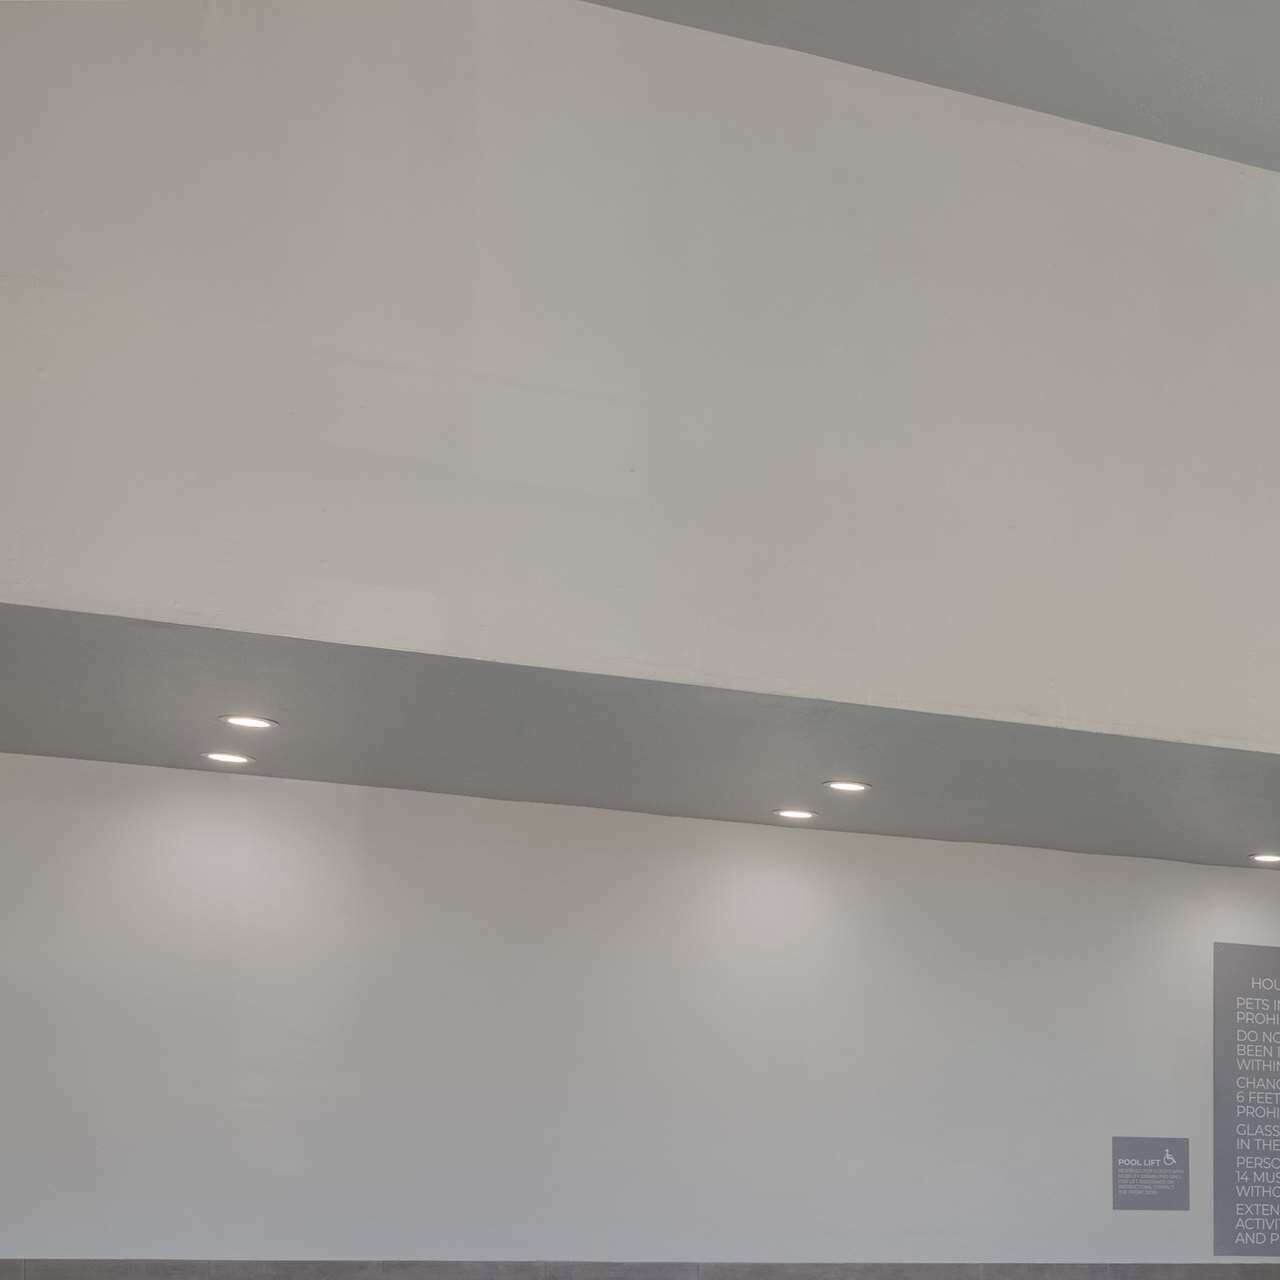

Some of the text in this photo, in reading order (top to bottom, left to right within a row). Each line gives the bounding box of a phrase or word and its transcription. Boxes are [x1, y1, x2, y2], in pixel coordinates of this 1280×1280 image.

[1235, 996, 1269, 1011] PETS
[1236, 1029, 1258, 1043] DO
[1236, 1044, 1273, 1058] BEEN
[1235, 1090, 1245, 1103] 6
[1248, 1091, 1280, 1105] FEET
[1235, 1123, 1280, 1137] GLASS
[1236, 1137, 1251, 1150] IN
[1254, 1138, 1280, 1151] THE
[1143, 1159, 1161, 1167] LIFT
[1235, 1171, 1248, 1183] 14
[1234, 1232, 1266, 1245] AND
